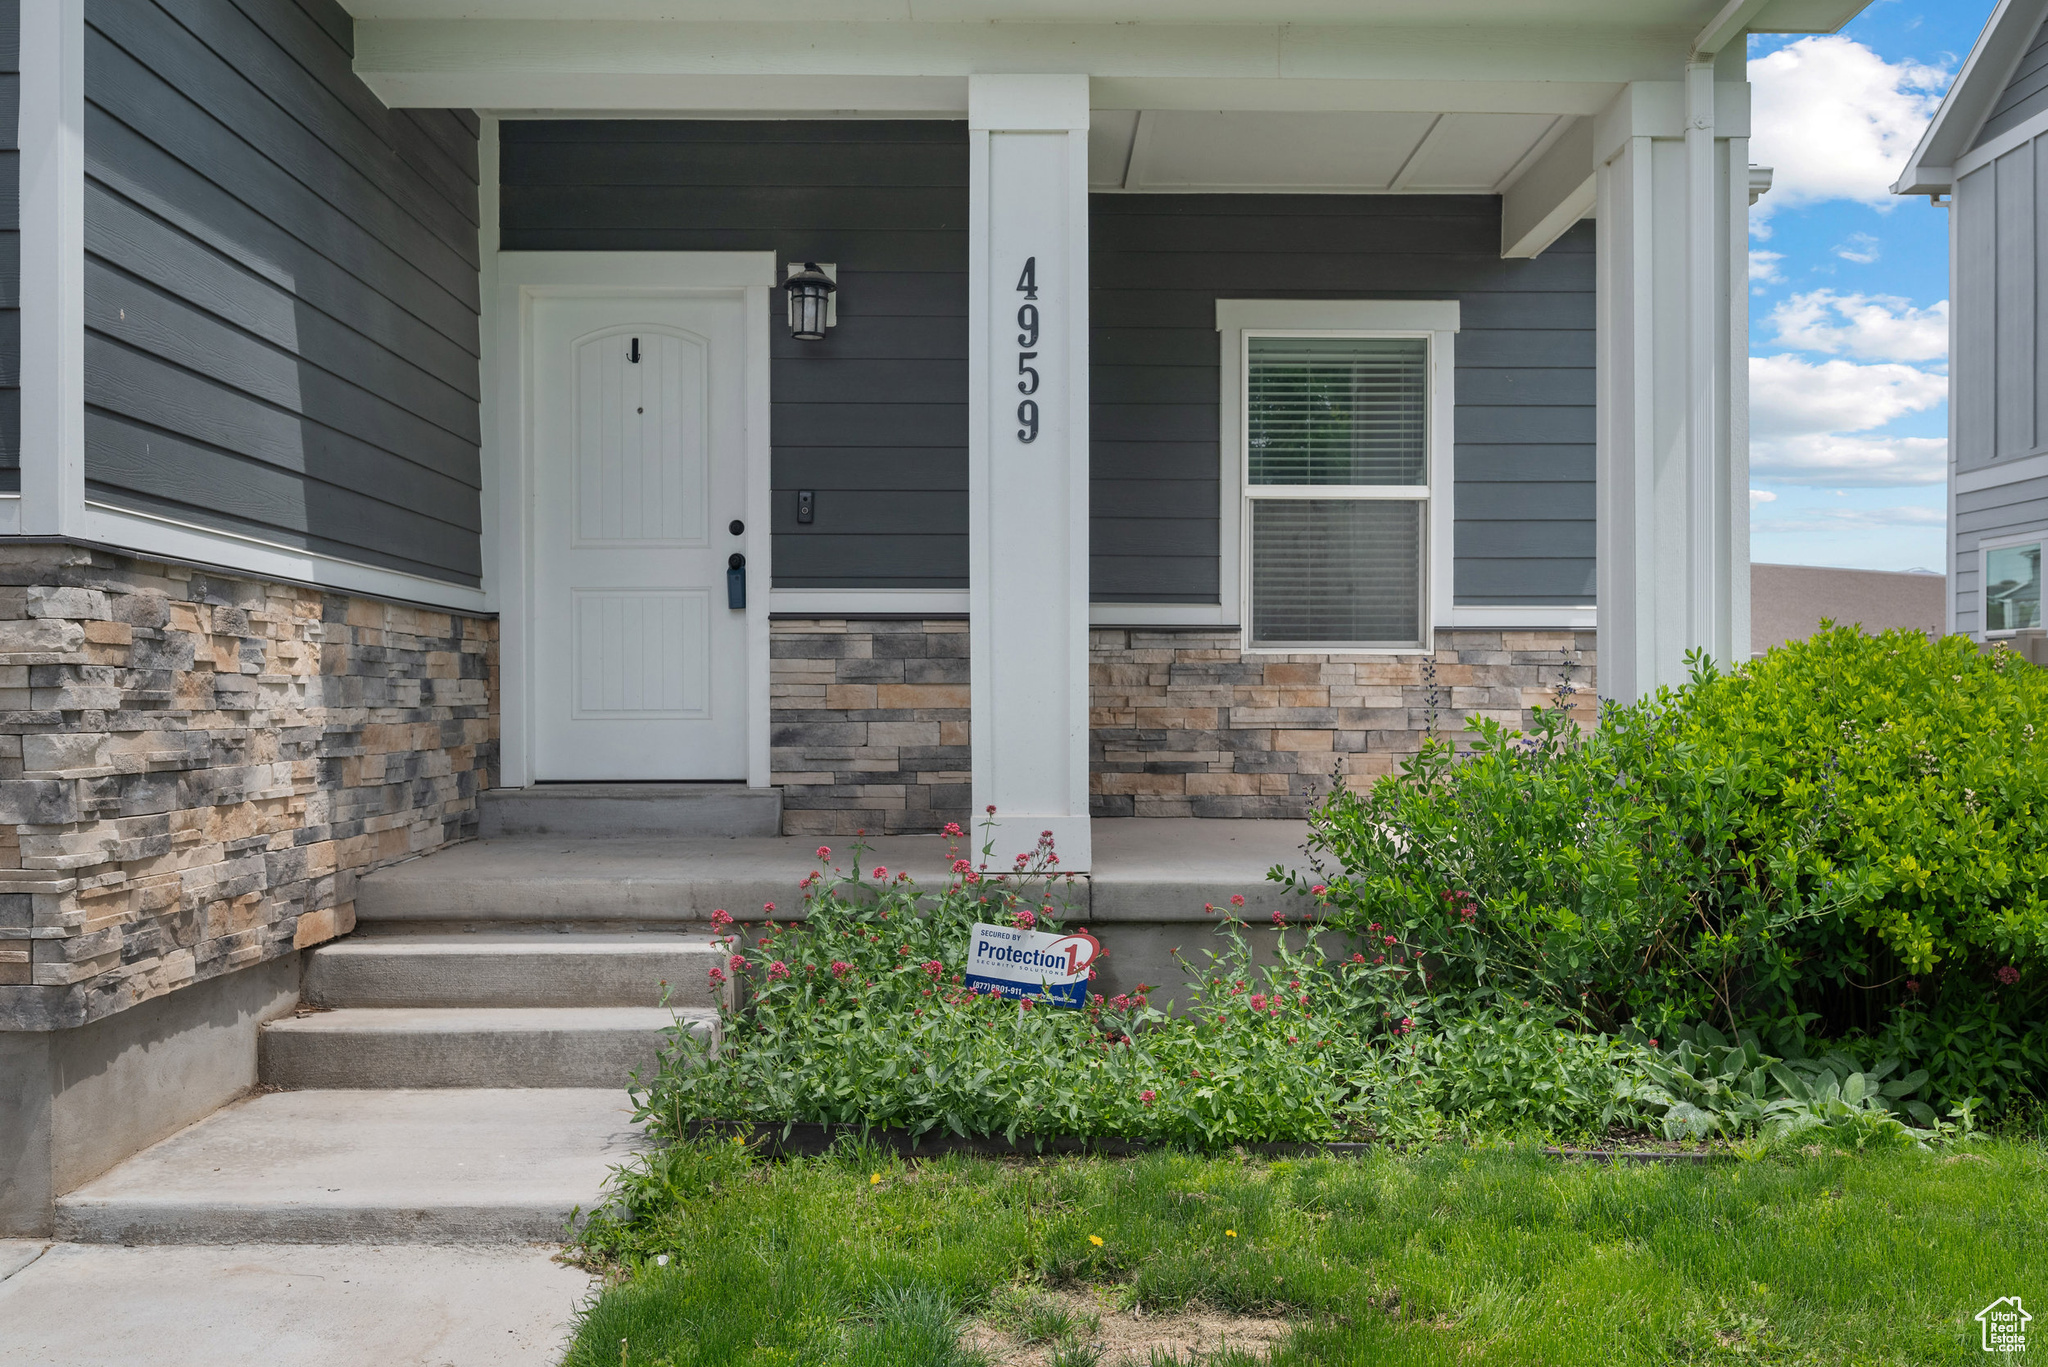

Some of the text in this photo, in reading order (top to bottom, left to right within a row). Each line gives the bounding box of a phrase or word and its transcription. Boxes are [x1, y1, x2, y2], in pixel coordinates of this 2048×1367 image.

[1016, 256, 1039, 444] 4959
[980, 929, 1010, 940] SECURED
[977, 940, 1066, 970] Protection
[976, 959, 1064, 977] SECURITY SOLUTIONS
